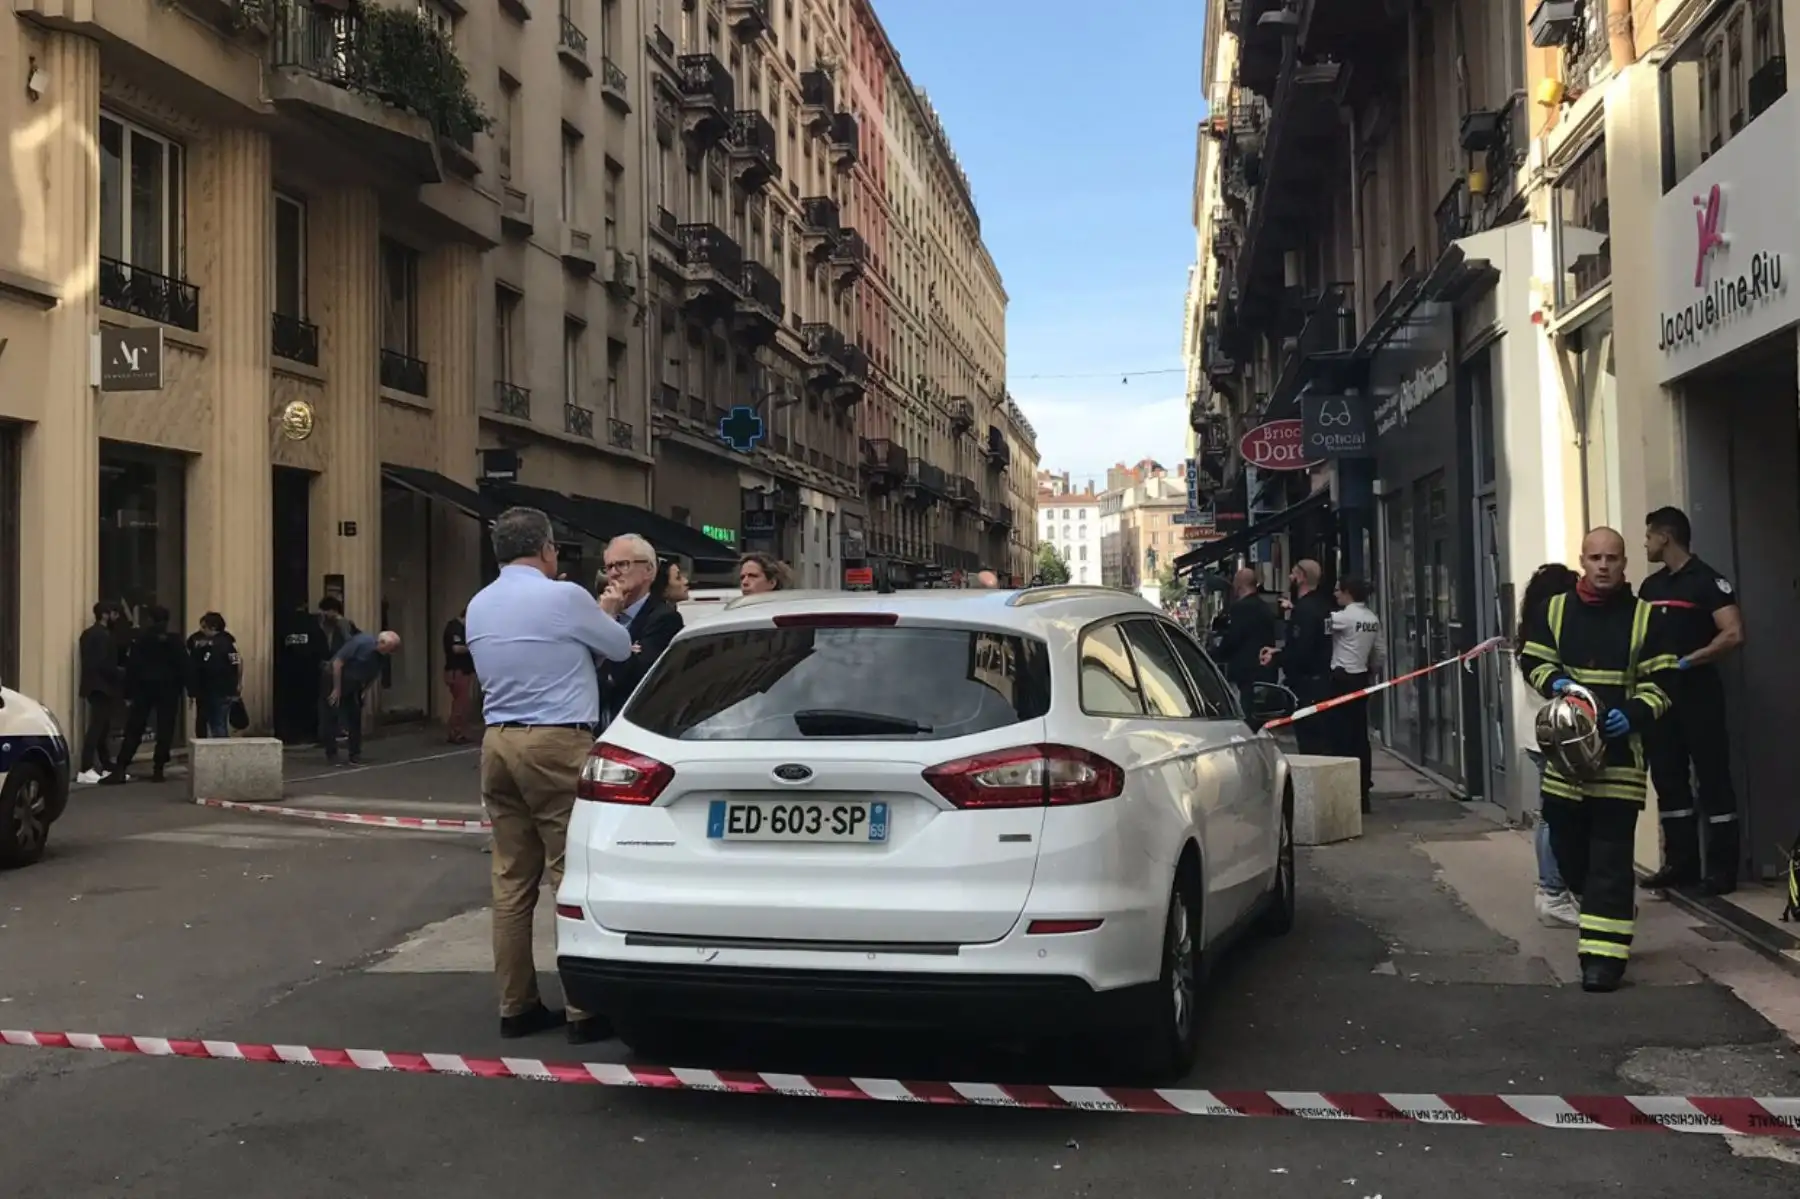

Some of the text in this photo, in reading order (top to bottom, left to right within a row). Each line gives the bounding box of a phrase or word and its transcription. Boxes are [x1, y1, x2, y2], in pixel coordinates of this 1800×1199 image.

[1659, 250, 1781, 351] Jacqueline Riu
[1263, 427, 1302, 440] Brioc
[1311, 431, 1366, 447] Optical
[1186, 459, 1197, 510] HOTEL
[1355, 621, 1379, 632] POLIC
[728, 805, 866, 835] ED-603-SP
[870, 824, 884, 838] 69
[1432, 1110, 1467, 1121] POLICE
[1630, 1114, 1724, 1126] FRANCHISSEMENT
[1748, 1114, 1800, 1128] ATIONALE
